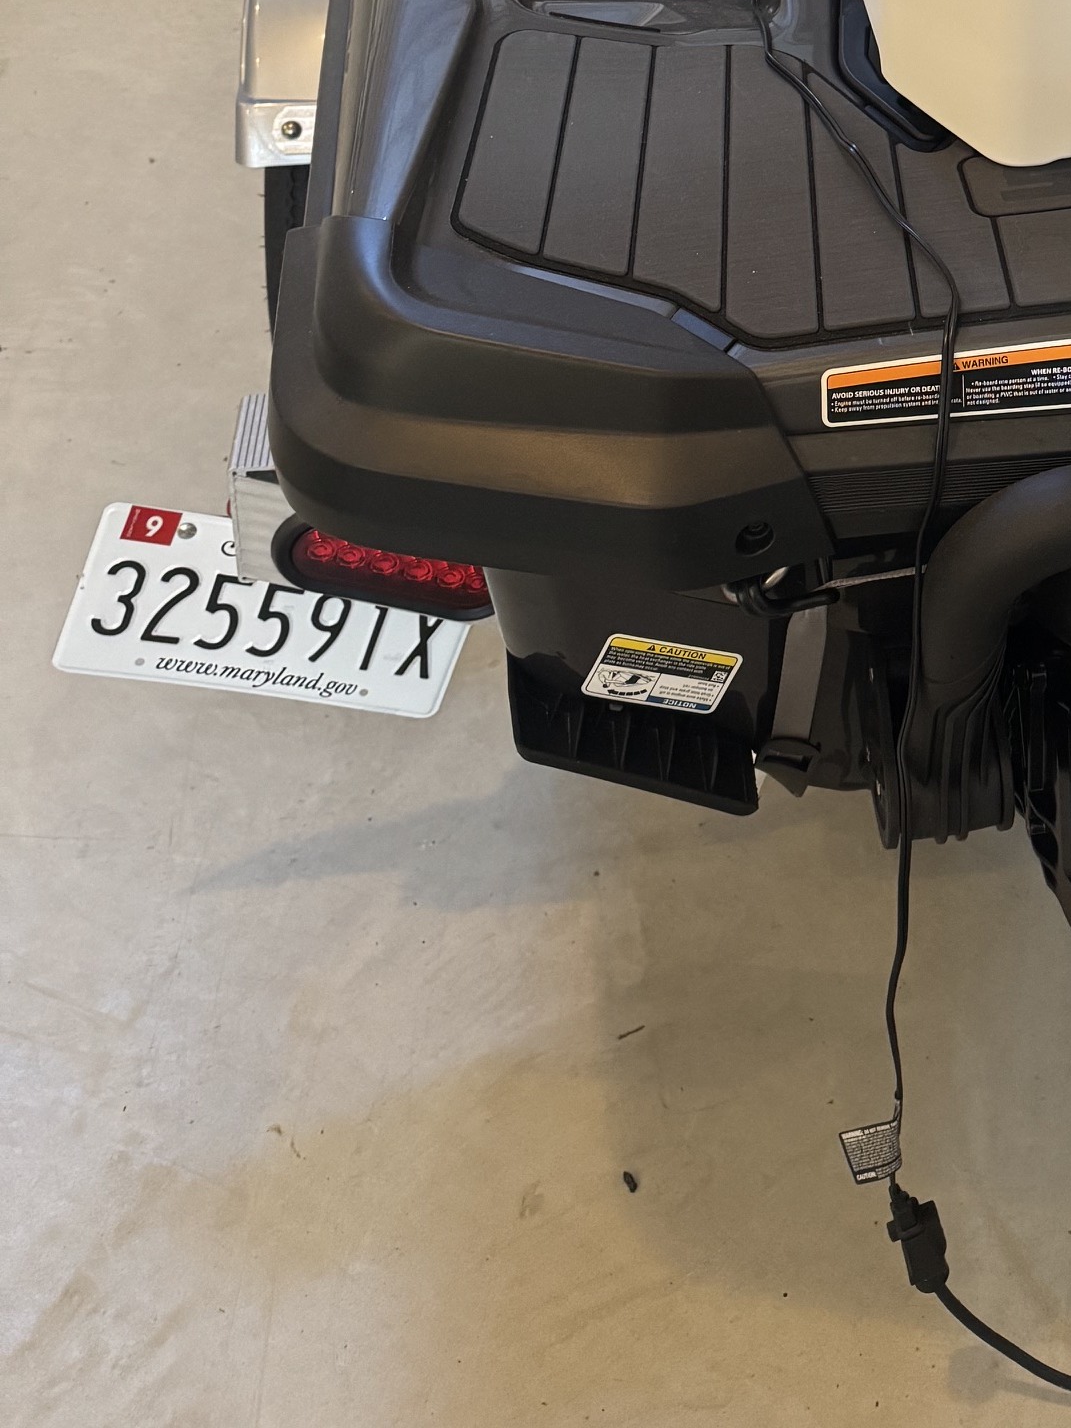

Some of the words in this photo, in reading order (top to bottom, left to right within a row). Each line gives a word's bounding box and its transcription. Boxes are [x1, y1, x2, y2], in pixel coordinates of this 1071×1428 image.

[962, 355, 1008, 368] WARNING
[1030, 367, 1051, 375] WHEN
[145, 515, 164, 537] 9
[91, 560, 443, 679] 325591X
[659, 646, 707, 660] CAUTION
[156, 656, 359, 698] www.maryland.gov
[663, 698, 697, 709] NOTICE
